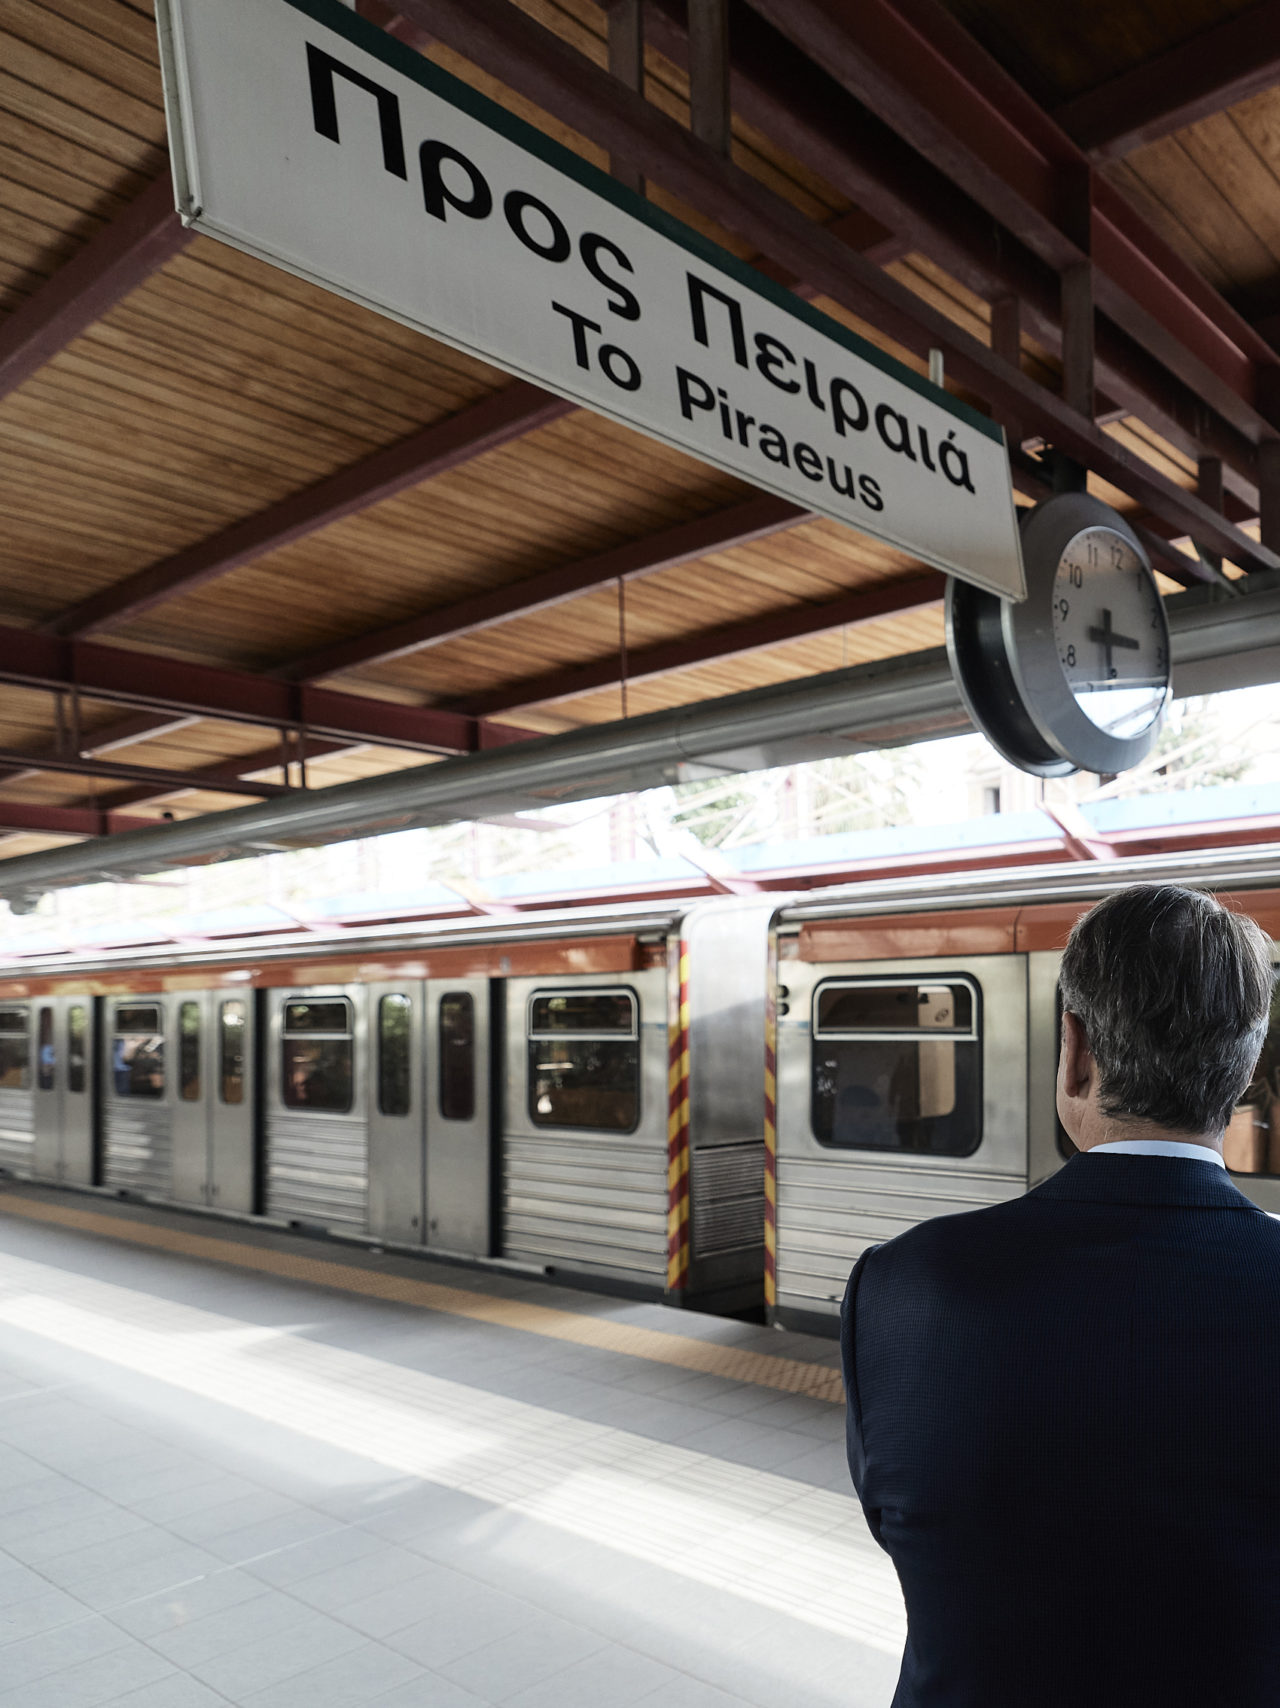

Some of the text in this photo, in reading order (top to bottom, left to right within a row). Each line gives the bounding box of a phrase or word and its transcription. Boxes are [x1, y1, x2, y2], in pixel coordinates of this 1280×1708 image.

[304, 40, 976, 495] Προς Πειραιά
[551, 300, 884, 512] To Piraeus
[1088, 543, 1098, 569] 11
[1110, 545, 1123, 571] 12
[1068, 562, 1082, 589] 10
[1058, 599, 1069, 622] 9
[1066, 644, 1076, 668] 8
